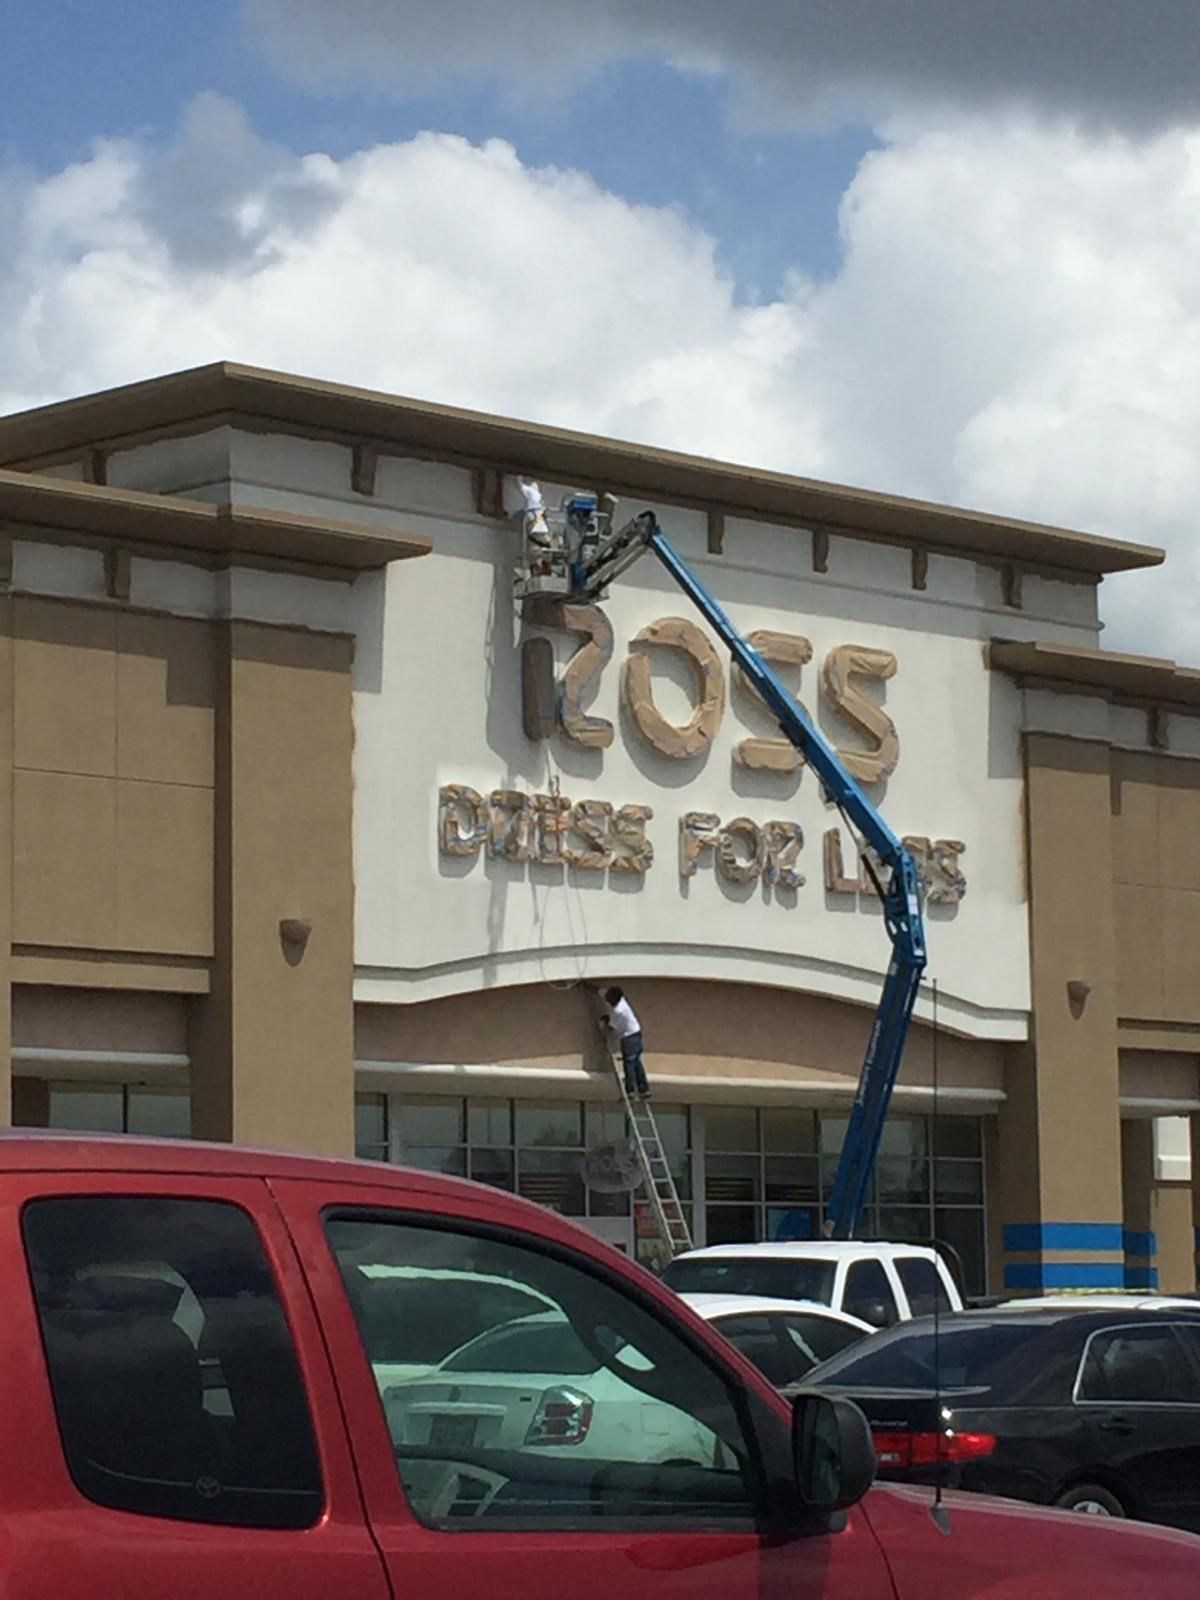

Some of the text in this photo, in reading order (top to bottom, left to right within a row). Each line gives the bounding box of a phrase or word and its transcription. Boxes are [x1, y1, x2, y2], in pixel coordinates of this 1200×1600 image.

[521, 602, 898, 783] ROSS
[439, 784, 654, 874] DRESS
[679, 811, 806, 888] FOR
